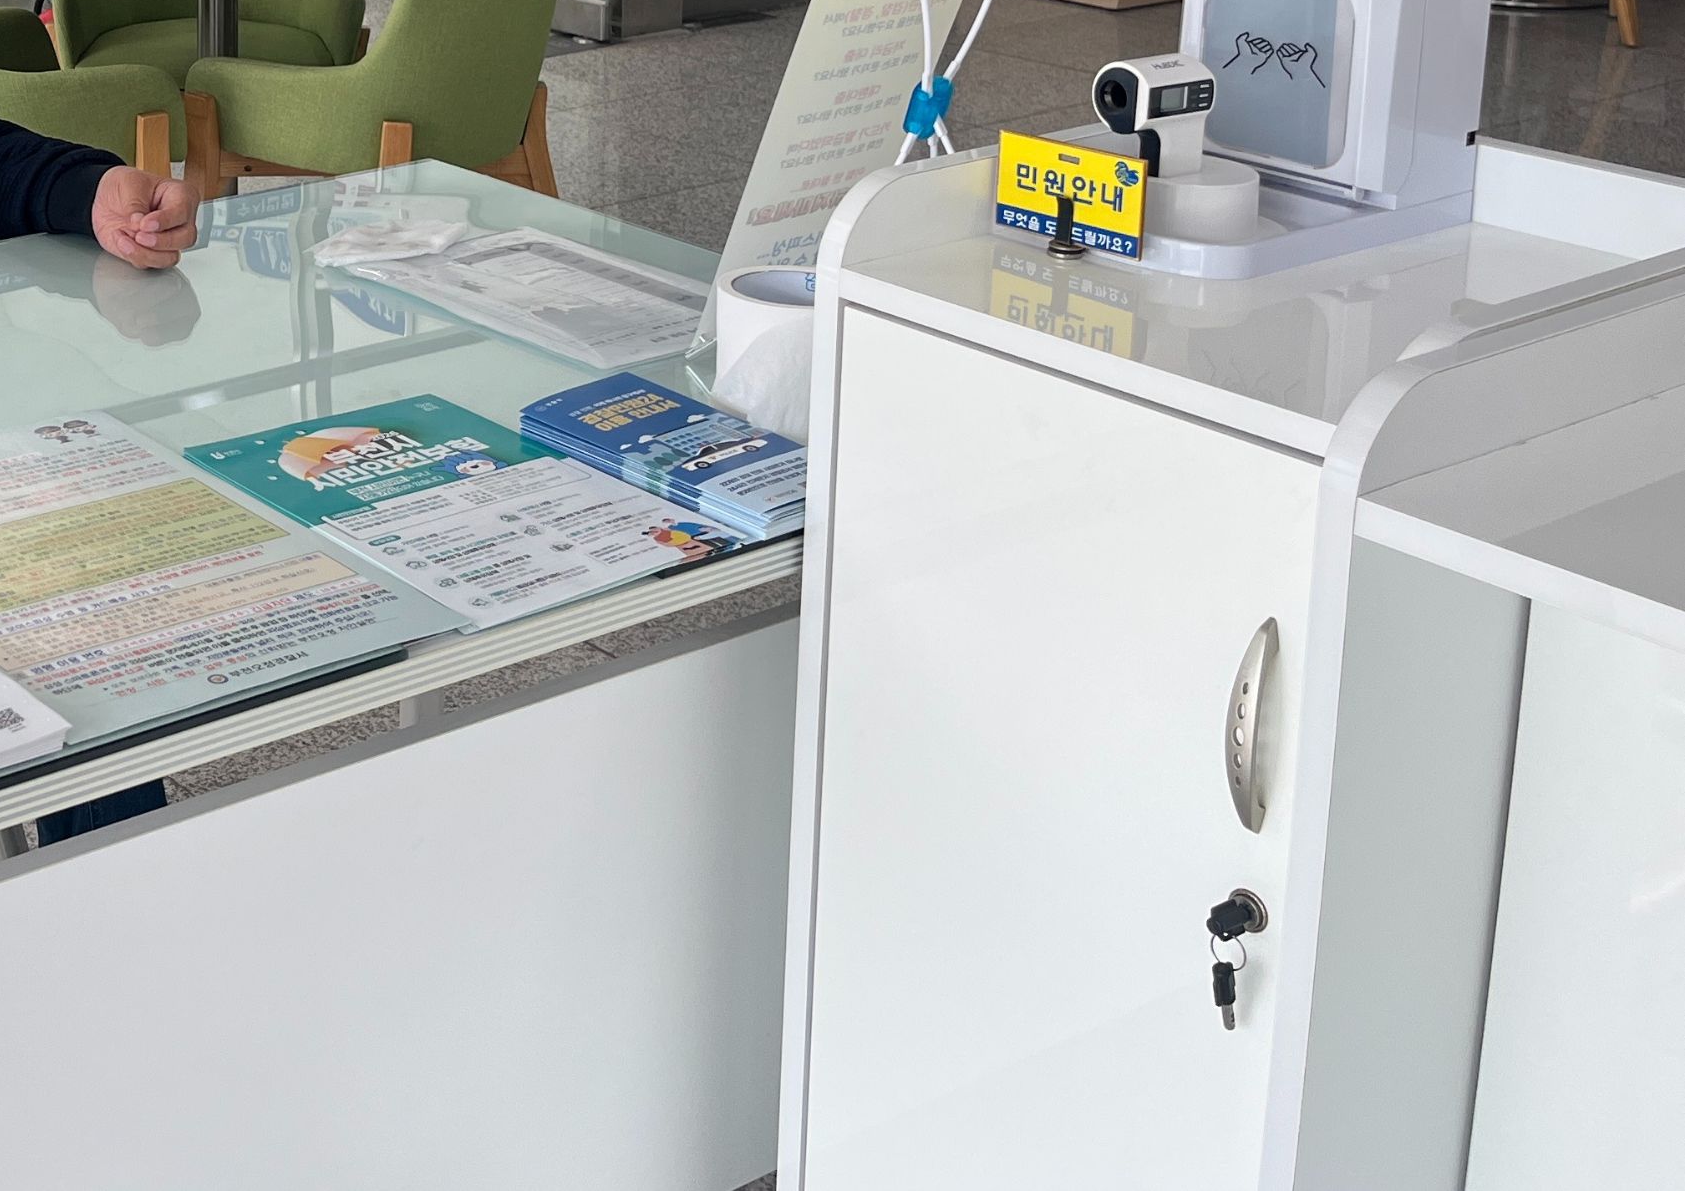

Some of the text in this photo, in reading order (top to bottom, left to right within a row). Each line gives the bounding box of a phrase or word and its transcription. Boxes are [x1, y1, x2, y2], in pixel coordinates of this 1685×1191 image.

[1016, 163, 1124, 213] 민원안내
[1002, 209, 1133, 255] 무엇을 도드릴까요?
[578, 393, 665, 425] 경찰민원24
[594, 417, 634, 431] 이용
[296, 435, 491, 492] 시민안전보험
[320, 434, 425, 466] 부천시
[225, 648, 311, 680] 부천오정경찰서
